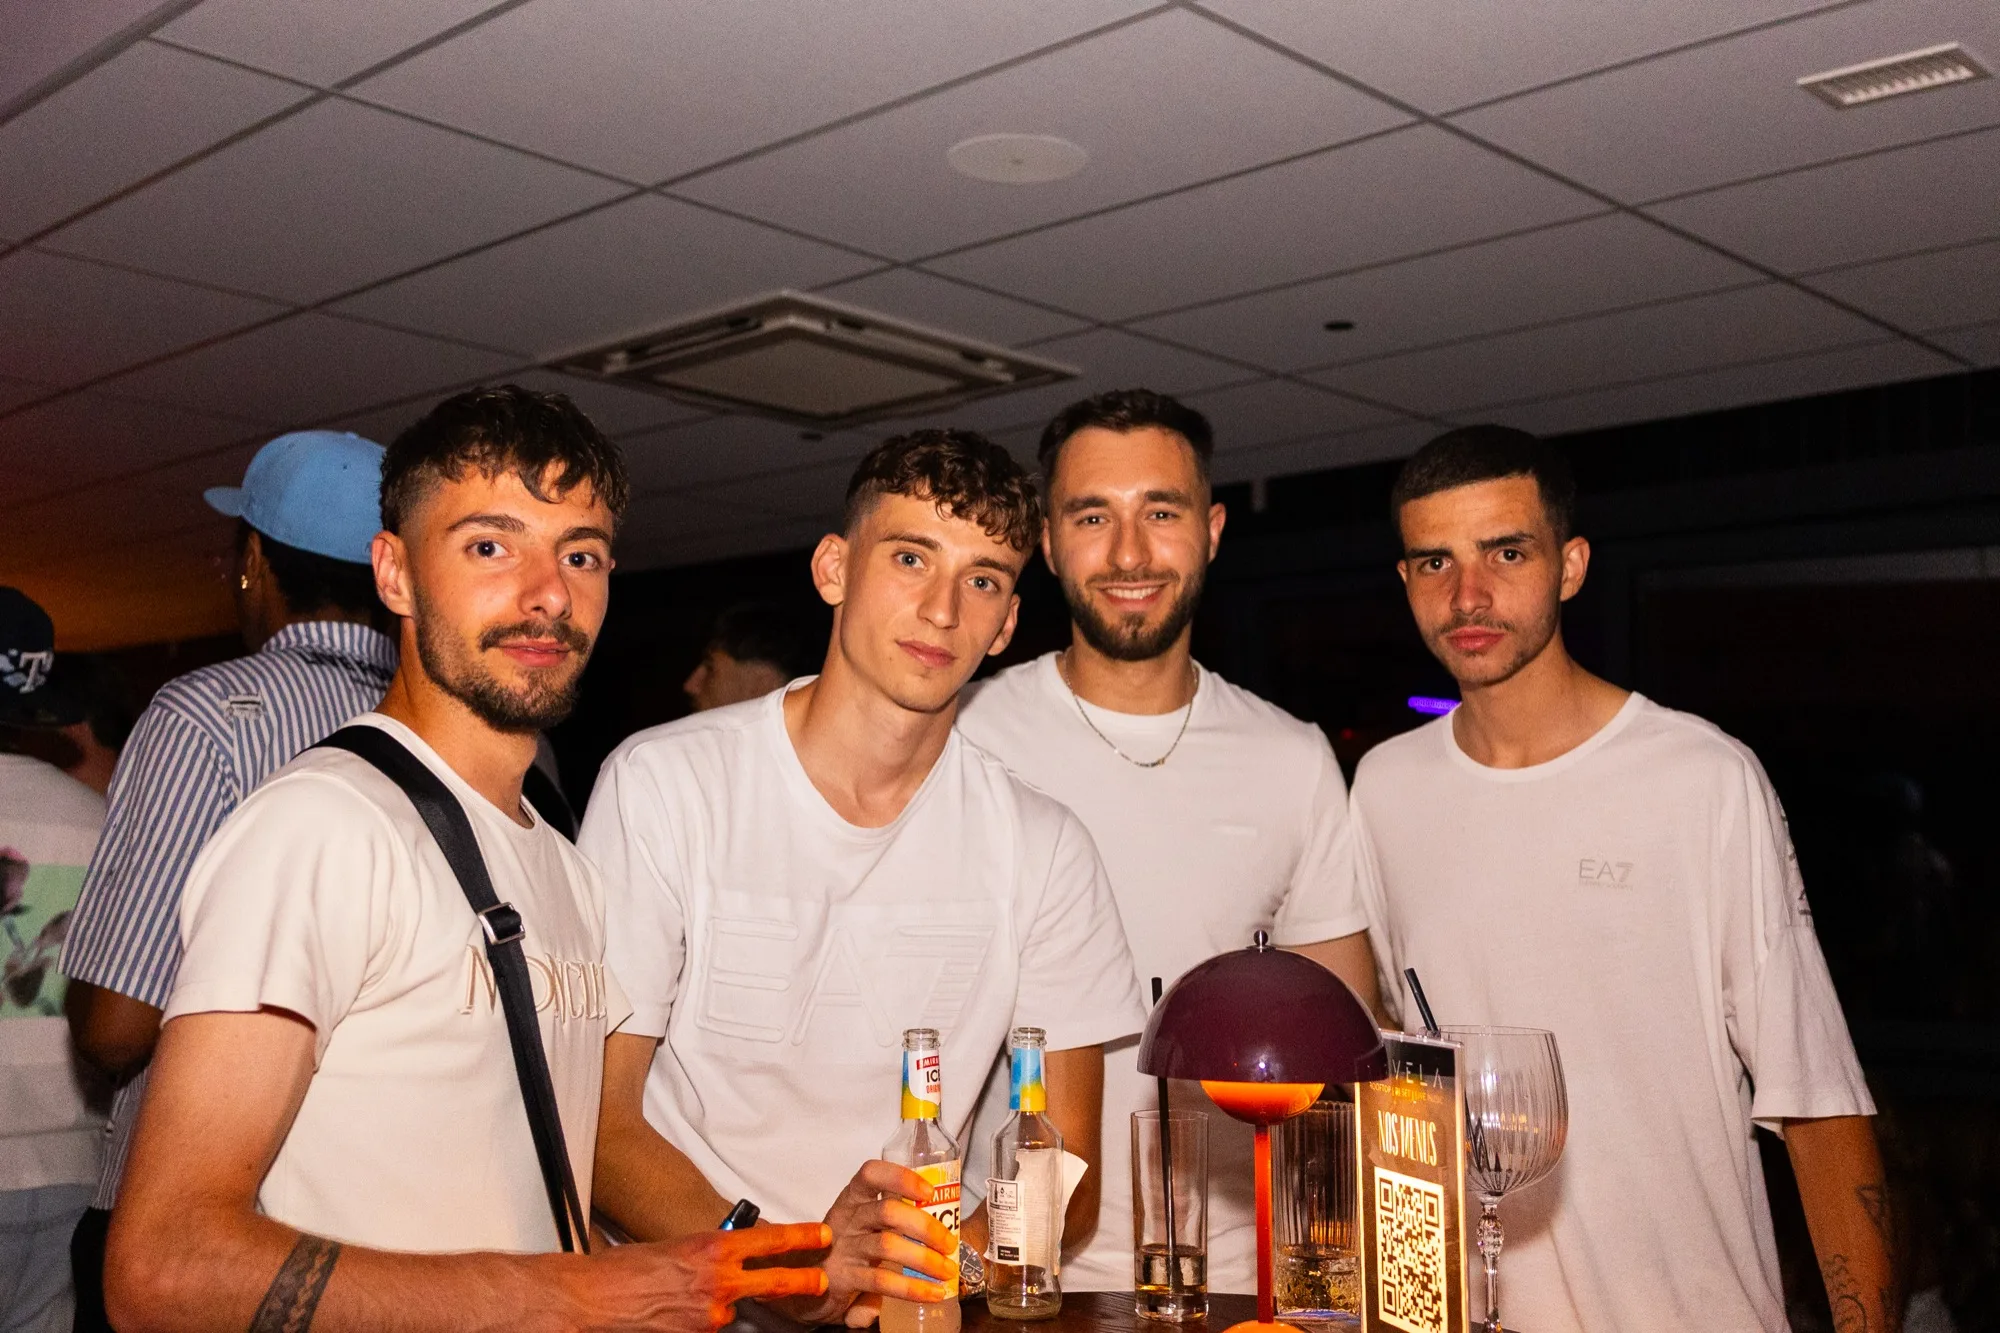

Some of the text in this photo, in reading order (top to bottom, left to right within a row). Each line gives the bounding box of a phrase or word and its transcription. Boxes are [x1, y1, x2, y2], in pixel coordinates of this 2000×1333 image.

[1579, 859, 1634, 882] EA7
[695, 916, 997, 1049] EA7
[1378, 1110, 1437, 1167] NOS MENUS
